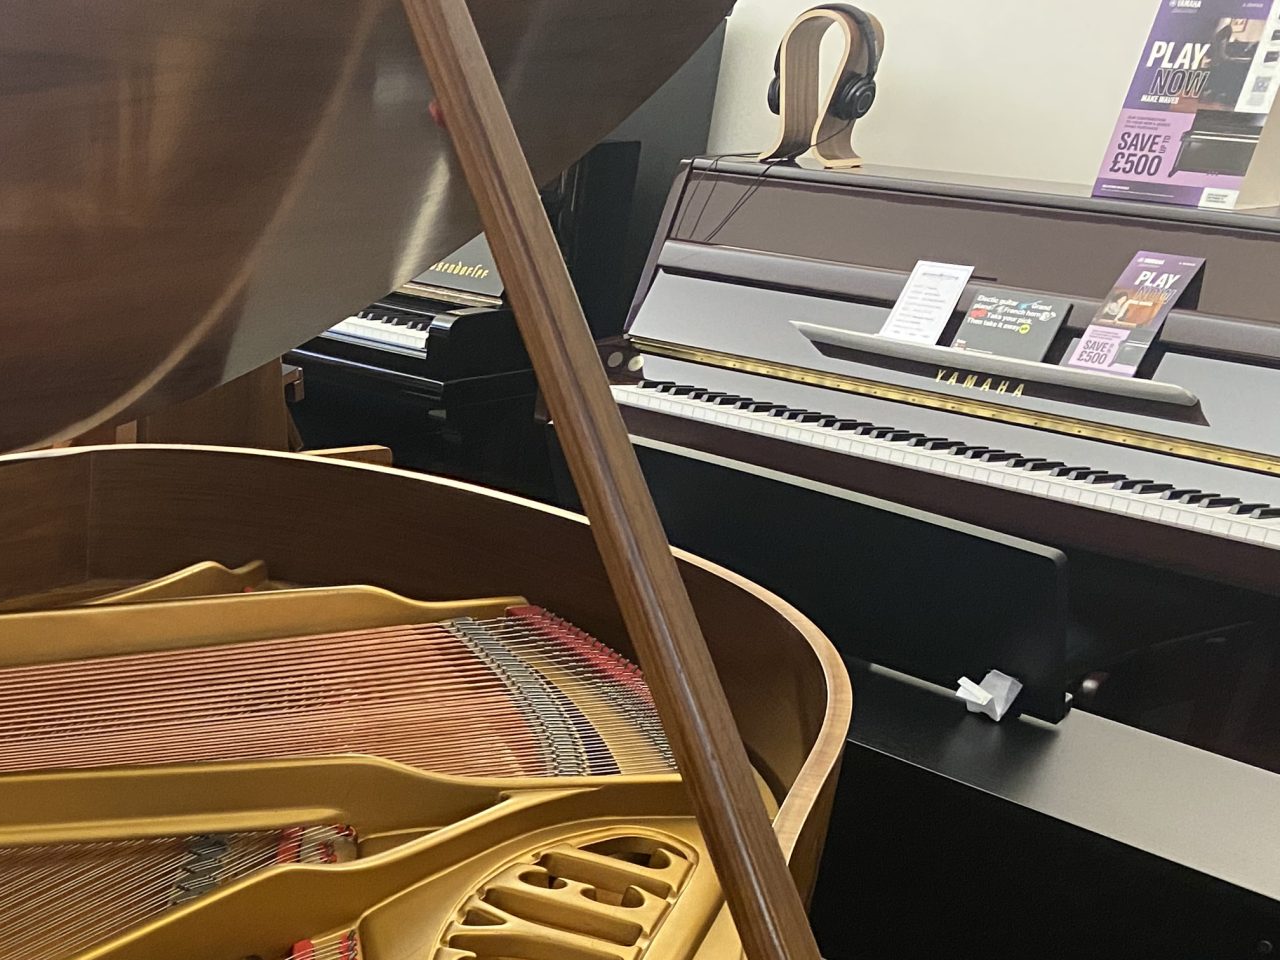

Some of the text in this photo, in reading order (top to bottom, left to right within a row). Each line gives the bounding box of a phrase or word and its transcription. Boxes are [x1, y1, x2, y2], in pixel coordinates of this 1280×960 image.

[1146, 41, 1211, 70] PLAY
[1149, 68, 1210, 98] NOW
[1140, 94, 1159, 102] MAKE
[1118, 131, 1162, 154] SAVE
[1109, 152, 1162, 176] £500
[1134, 271, 1181, 289] PLAY
[967, 317, 983, 325] Then
[987, 312, 1002, 320] Take
[1083, 340, 1109, 352] SAVE
[1077, 350, 1107, 364] £500
[935, 369, 1025, 398] YAMAHA
